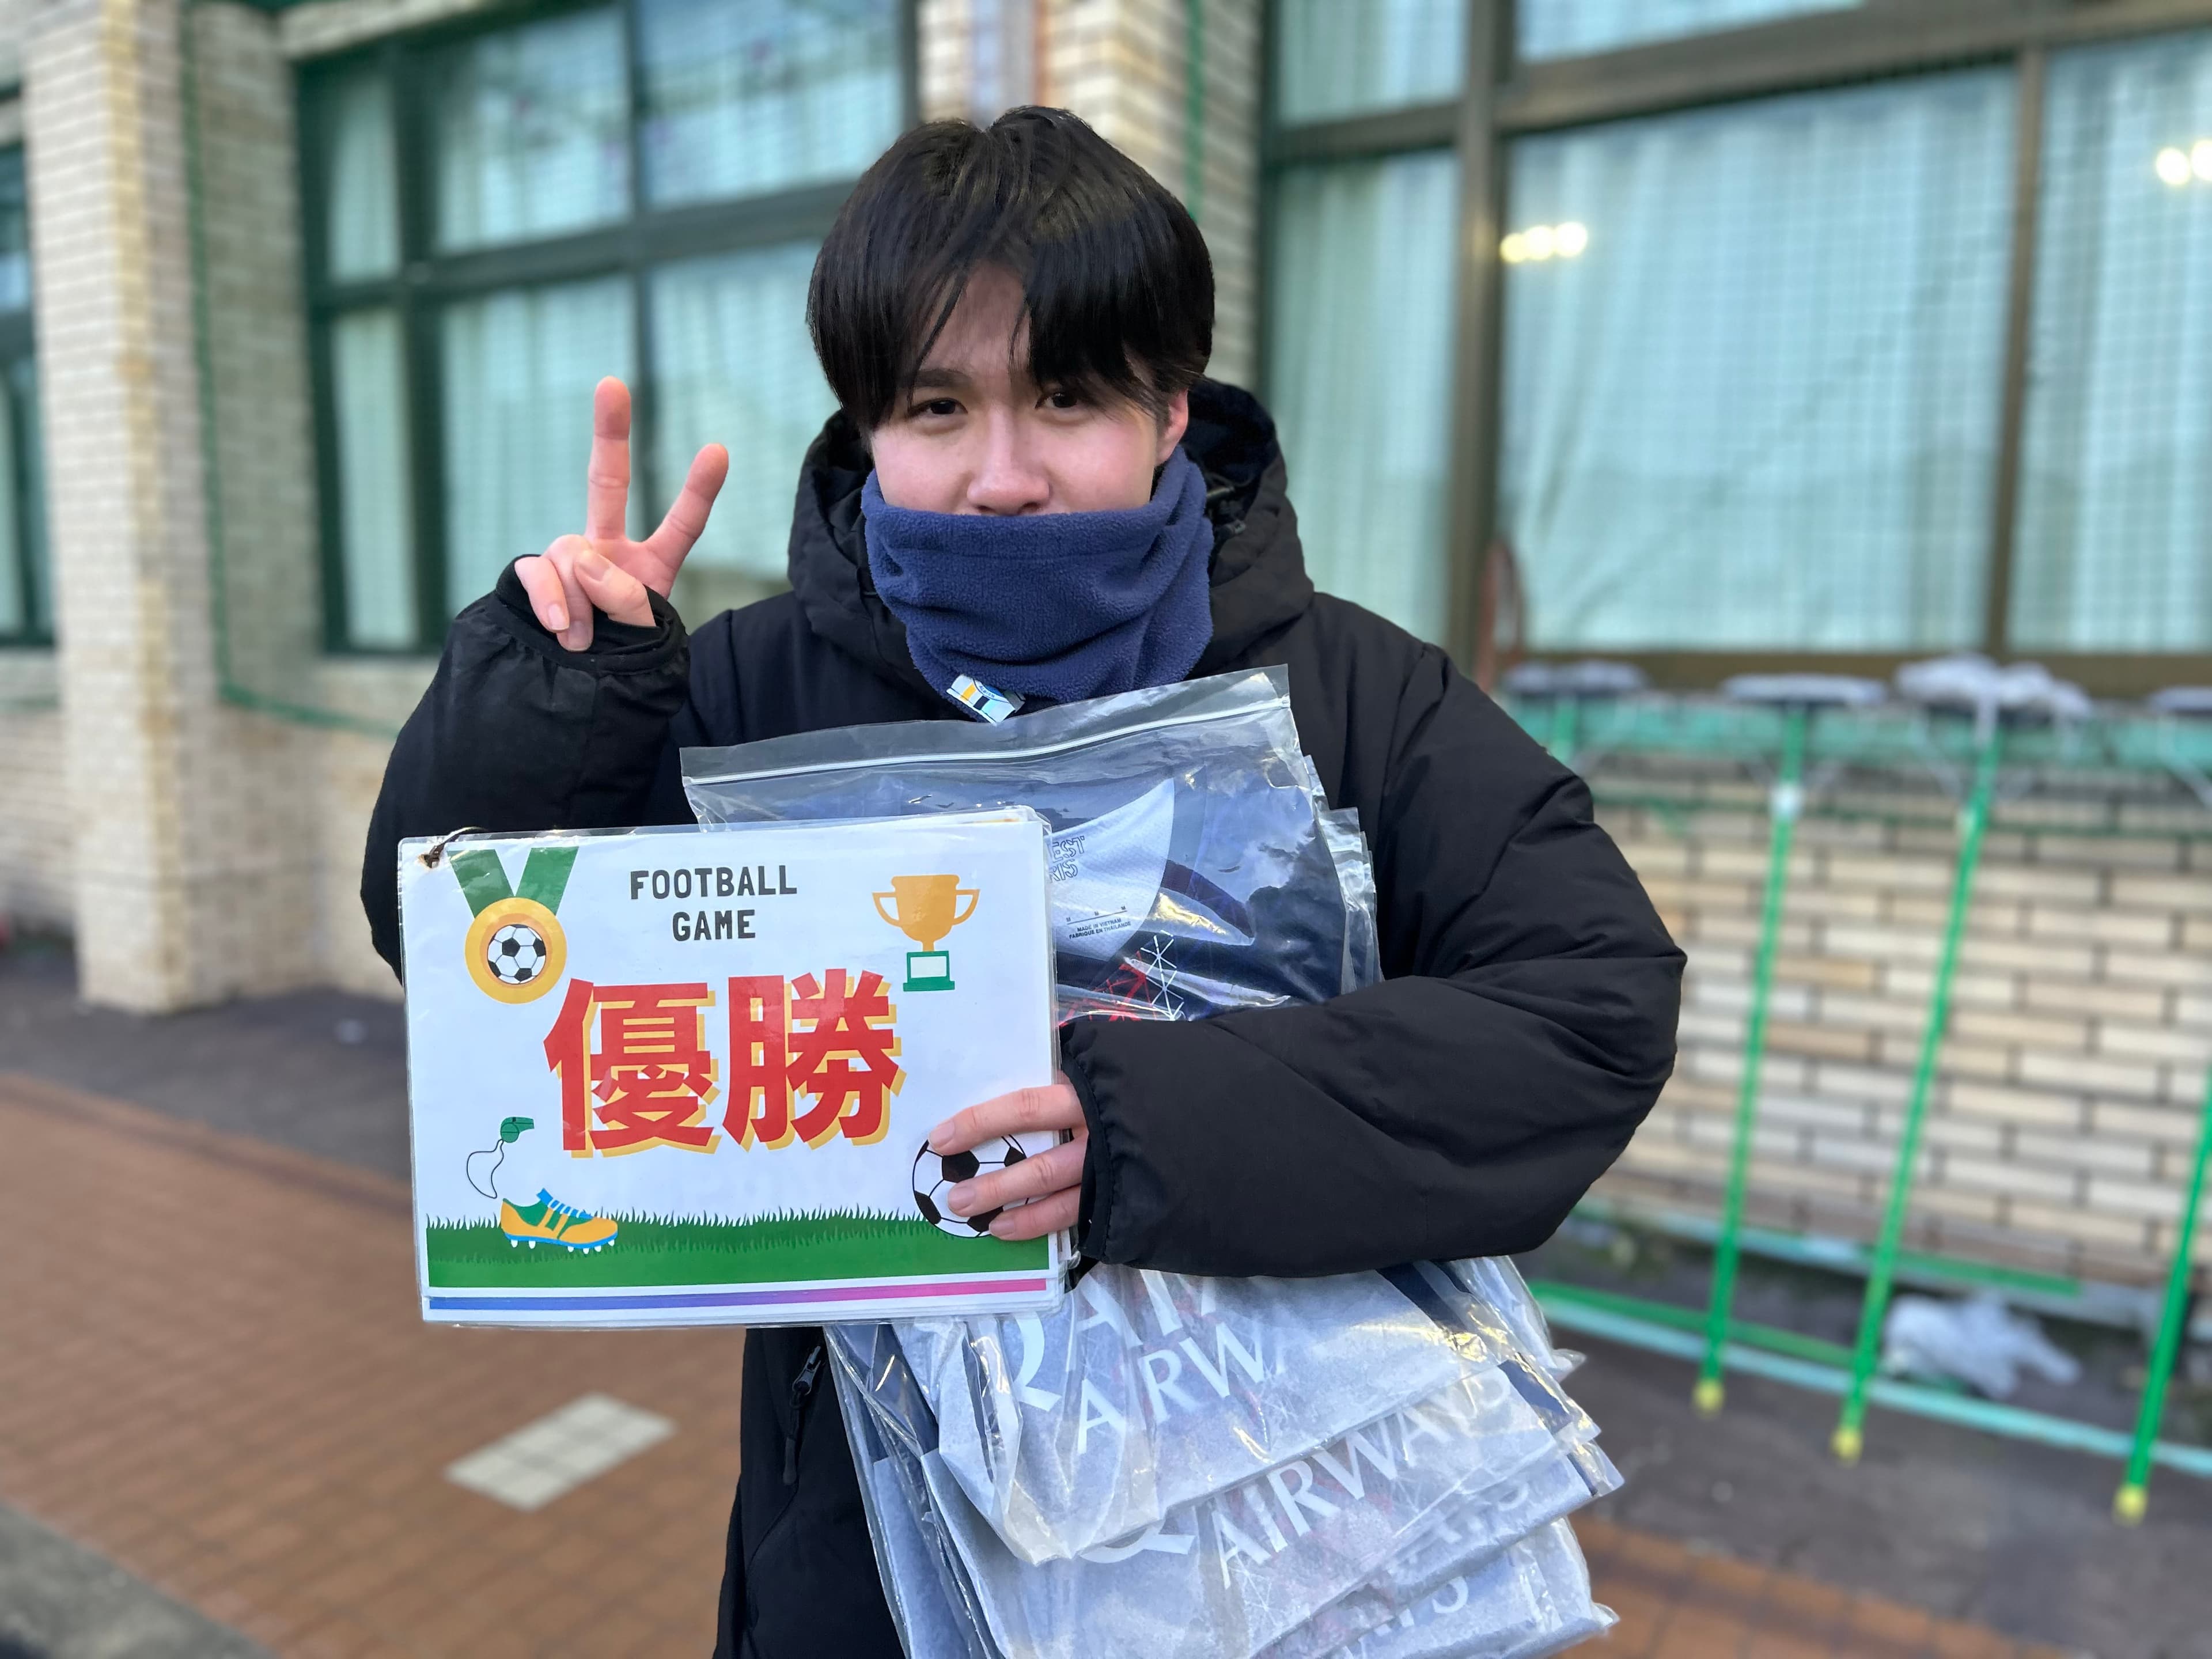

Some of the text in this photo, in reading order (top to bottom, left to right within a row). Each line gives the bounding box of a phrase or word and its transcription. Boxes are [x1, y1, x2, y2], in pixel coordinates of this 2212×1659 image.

[630, 865, 797, 900] FOOTBALL
[672, 909, 756, 941] GAME
[1100, 918, 1121, 927] VIETNAM
[543, 968, 901, 1156] 優勝
